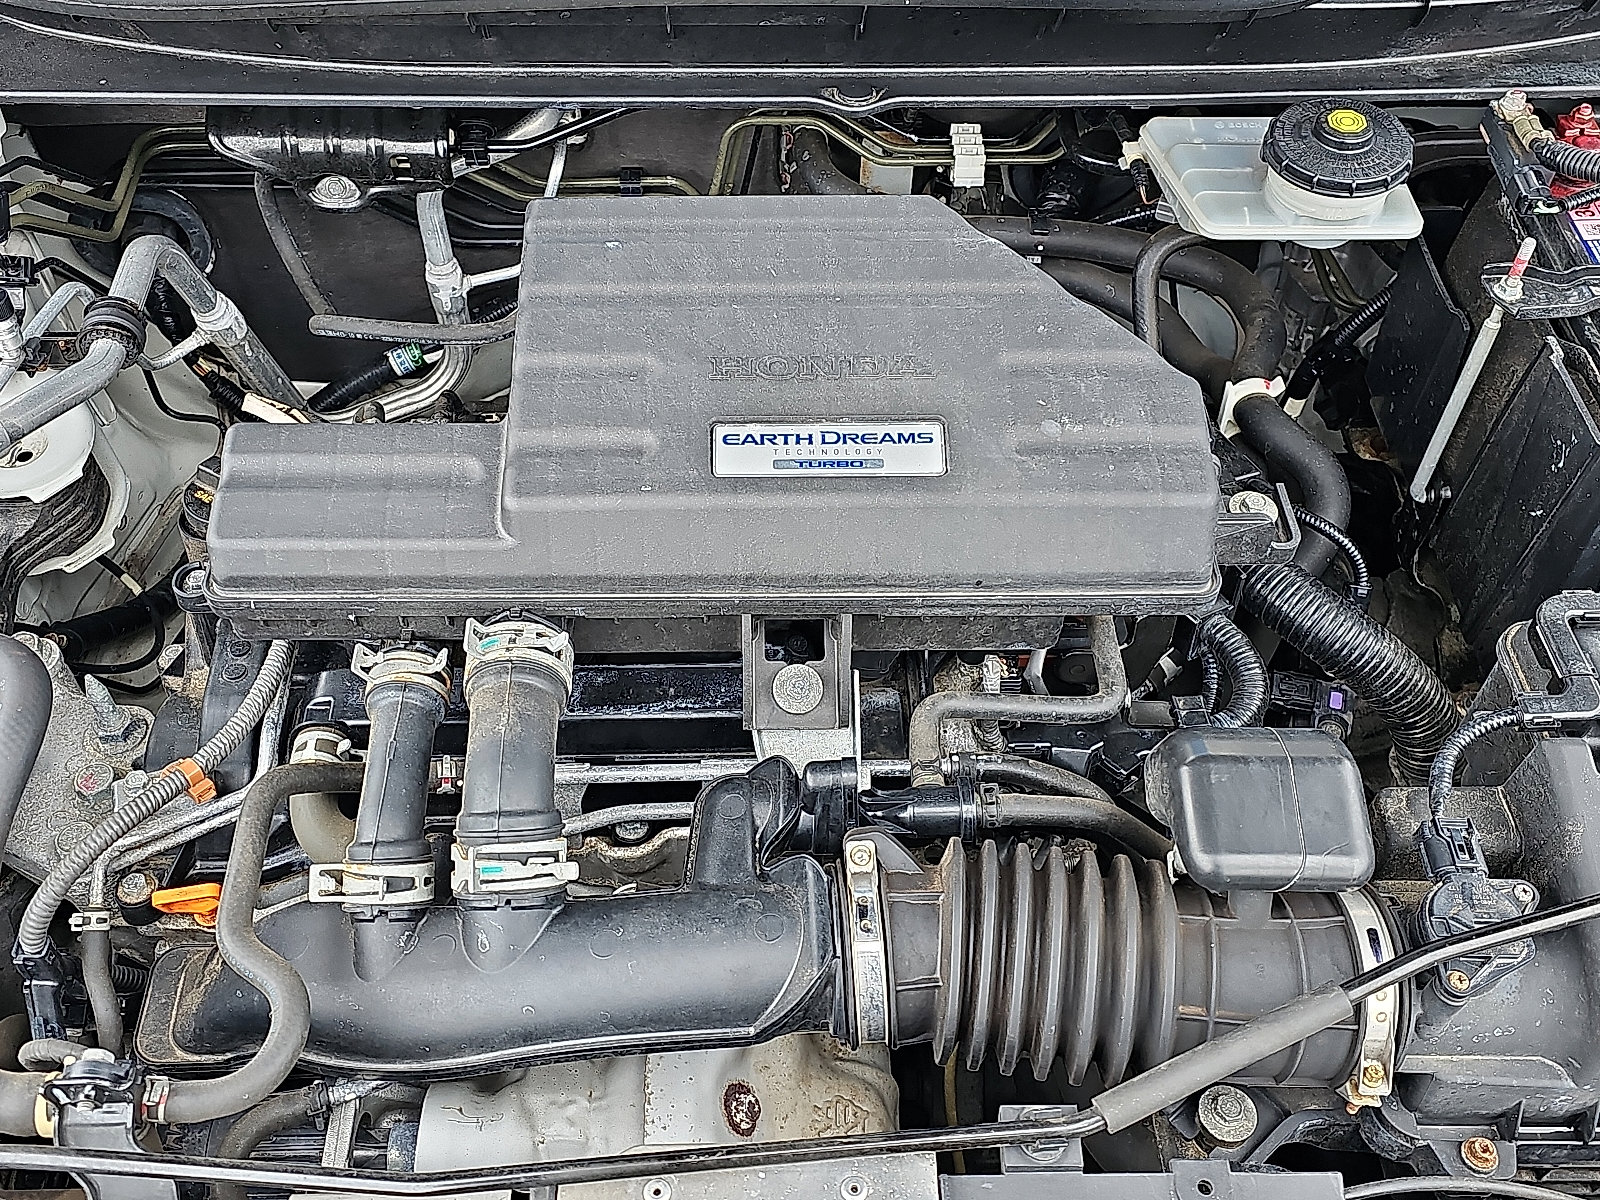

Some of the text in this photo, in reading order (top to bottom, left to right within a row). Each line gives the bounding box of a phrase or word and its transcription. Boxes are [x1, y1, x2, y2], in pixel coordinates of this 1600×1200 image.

[707, 355, 936, 380] HONDA
[722, 431, 934, 446] EARTH DREAMS
[773, 448, 883, 456] TECHNOLOGY
[794, 459, 865, 468] TURBO
